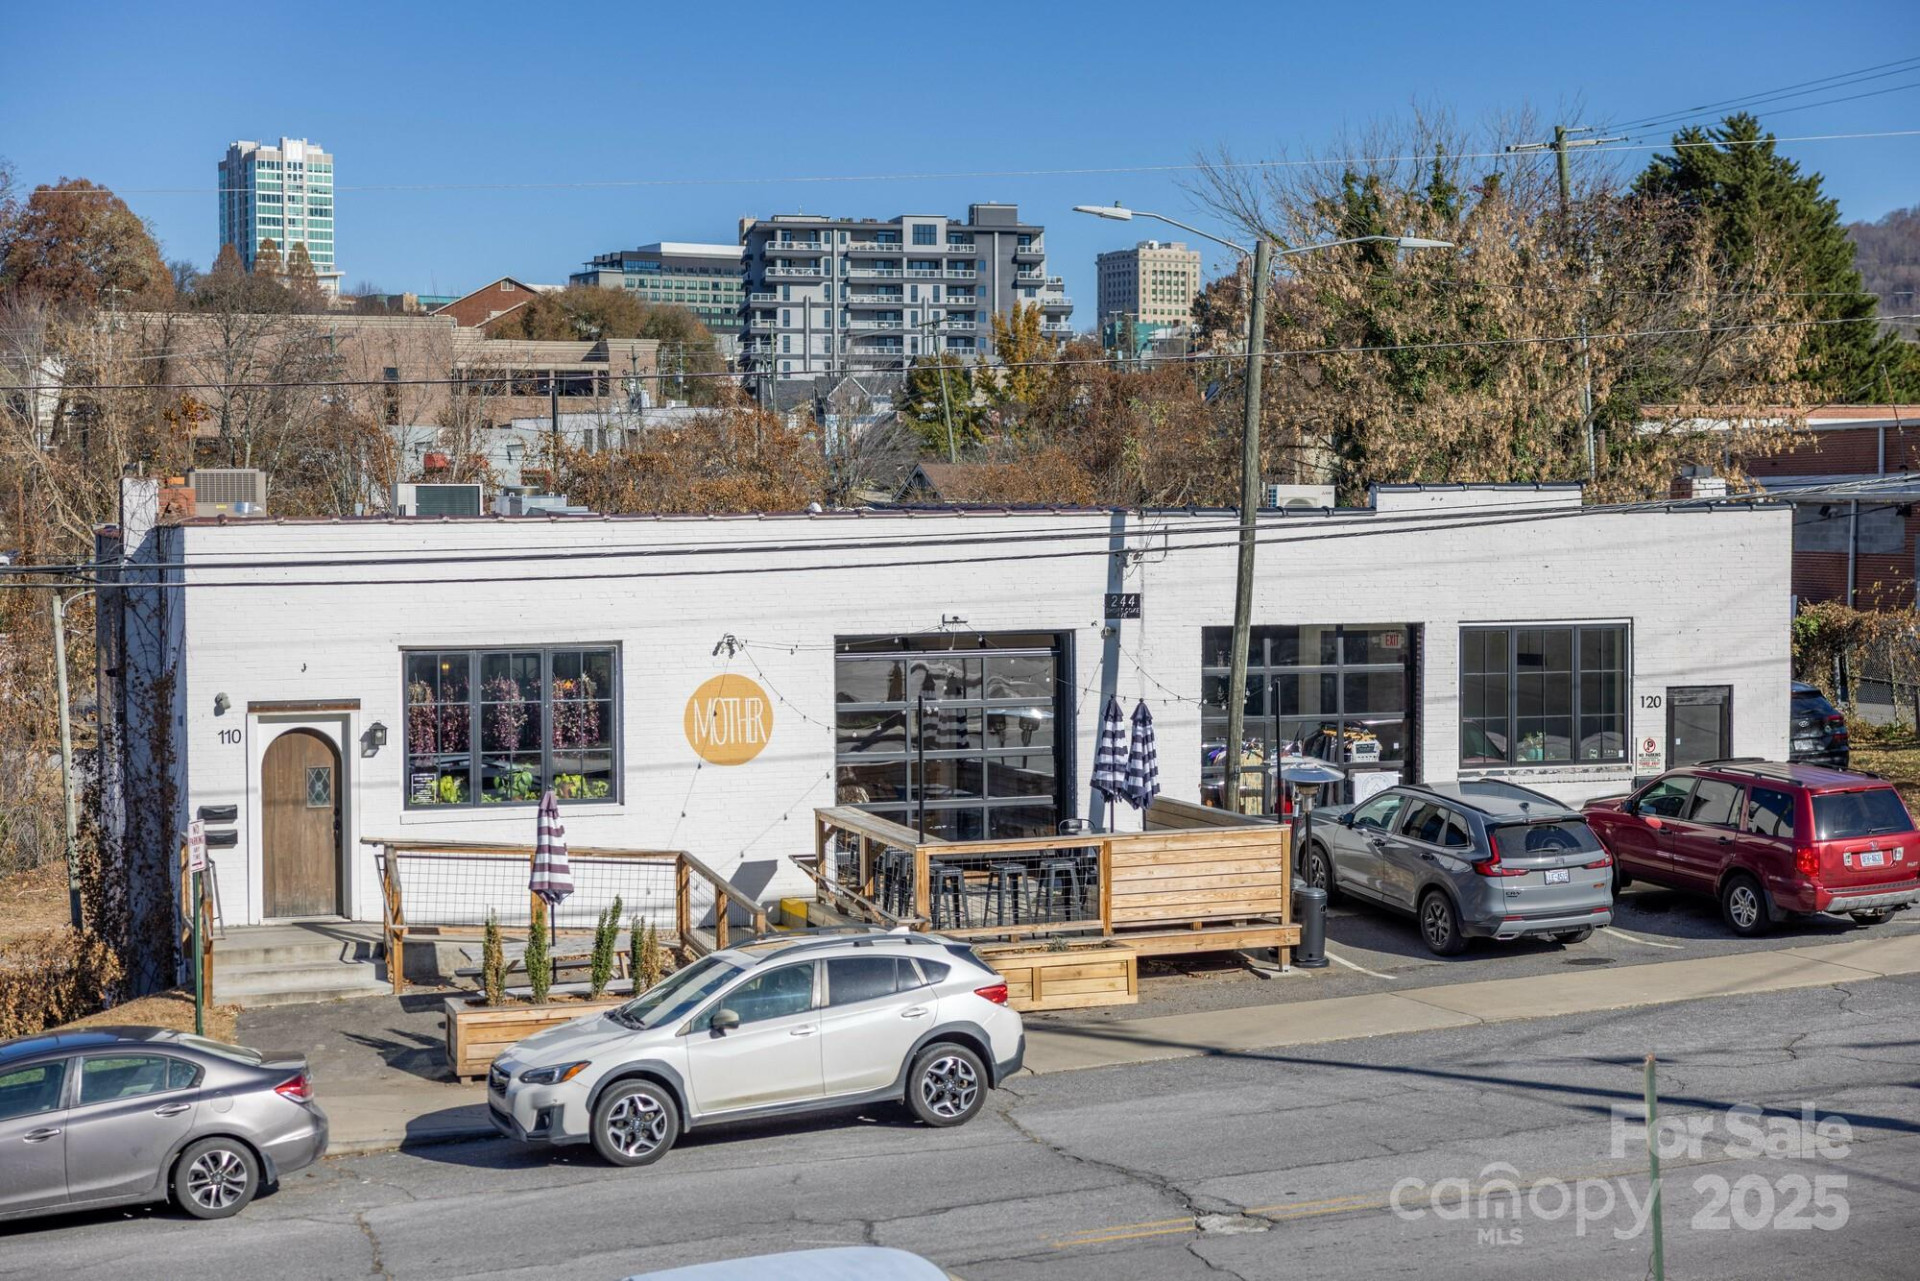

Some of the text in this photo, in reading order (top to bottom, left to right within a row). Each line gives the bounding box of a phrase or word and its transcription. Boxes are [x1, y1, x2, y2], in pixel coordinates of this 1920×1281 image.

[1111, 594, 1135, 607] 244
[1386, 634, 1398, 646] EXIT
[1640, 695, 1662, 708] 120
[694, 697, 767, 745] MOTHER
[217, 729, 242, 744] 110
[193, 824, 200, 835] NO
[189, 835, 204, 845] PARKING
